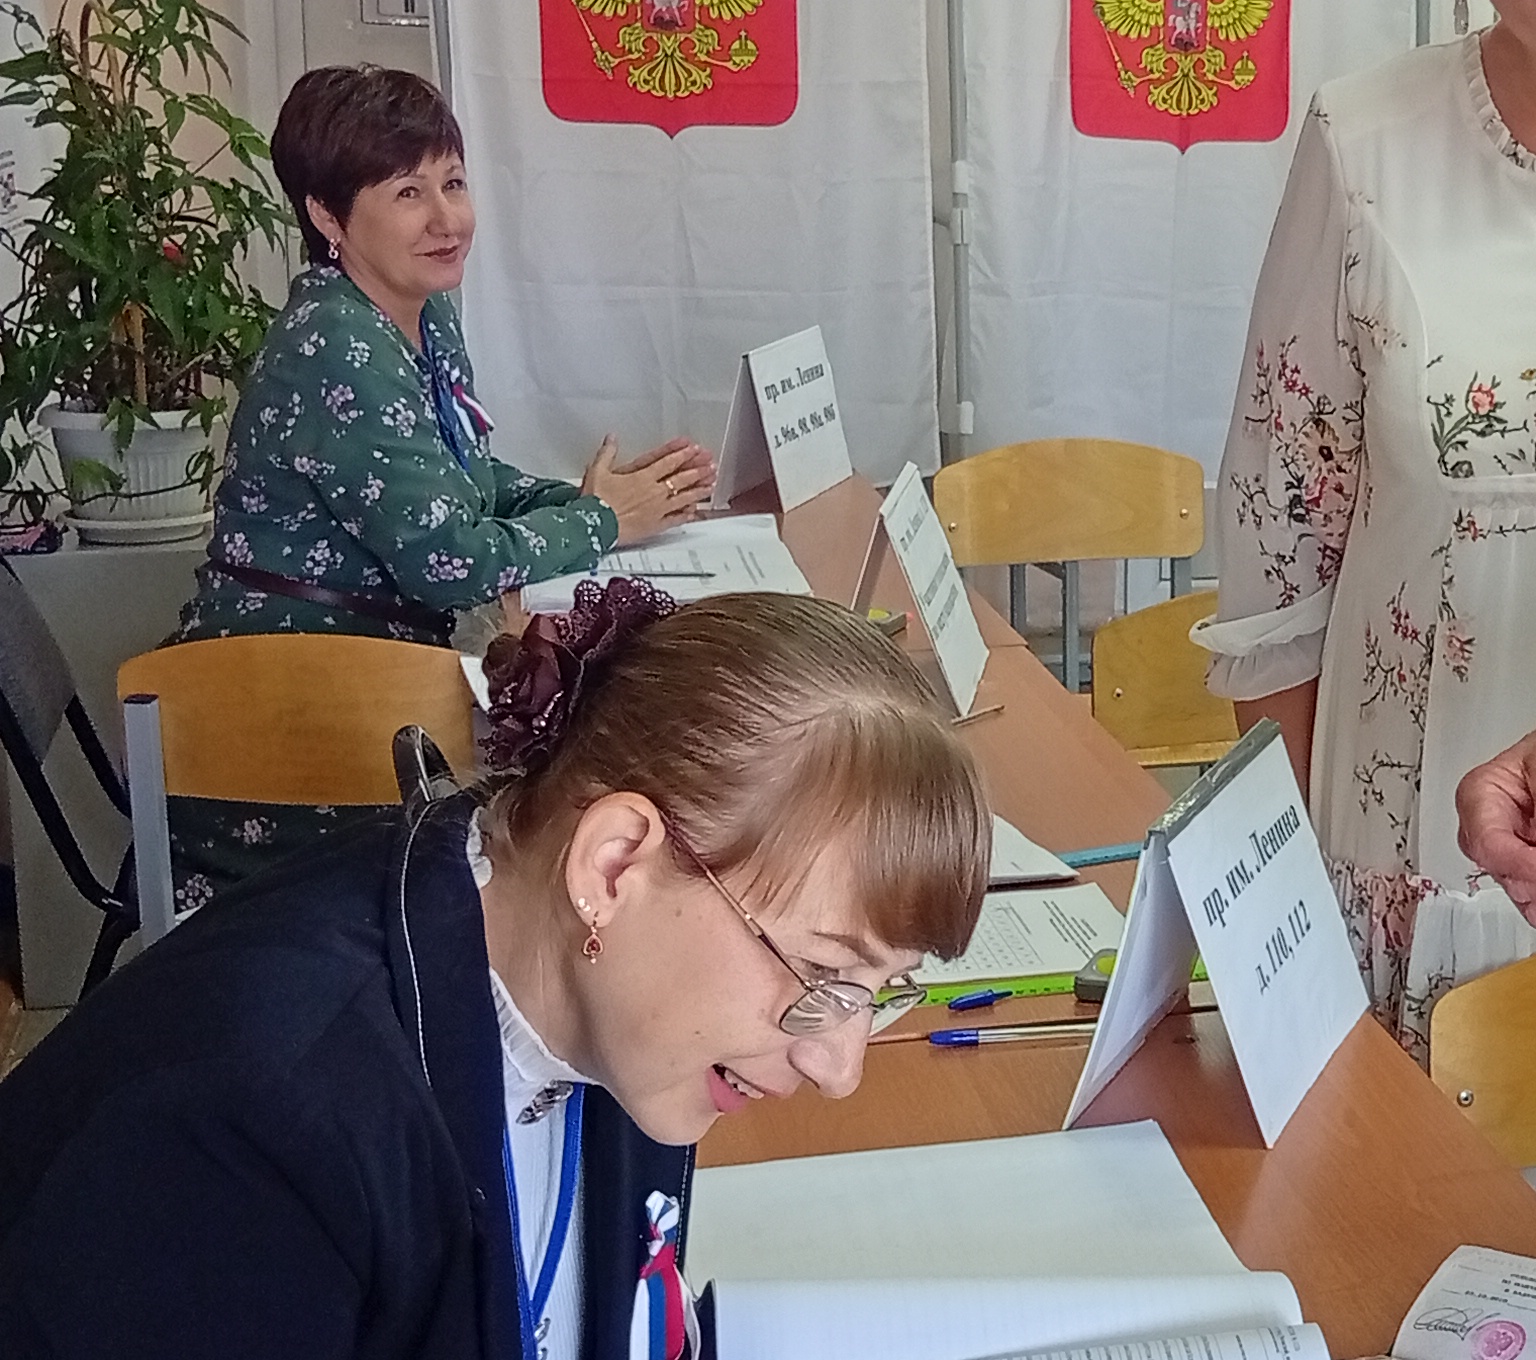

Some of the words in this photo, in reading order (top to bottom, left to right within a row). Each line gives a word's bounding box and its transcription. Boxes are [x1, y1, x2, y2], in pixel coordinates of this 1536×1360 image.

[1202, 886, 1230, 929] пр.
[1225, 858, 1255, 901] им.
[1248, 803, 1301, 875] Ленина
[1287, 898, 1312, 947] 112
